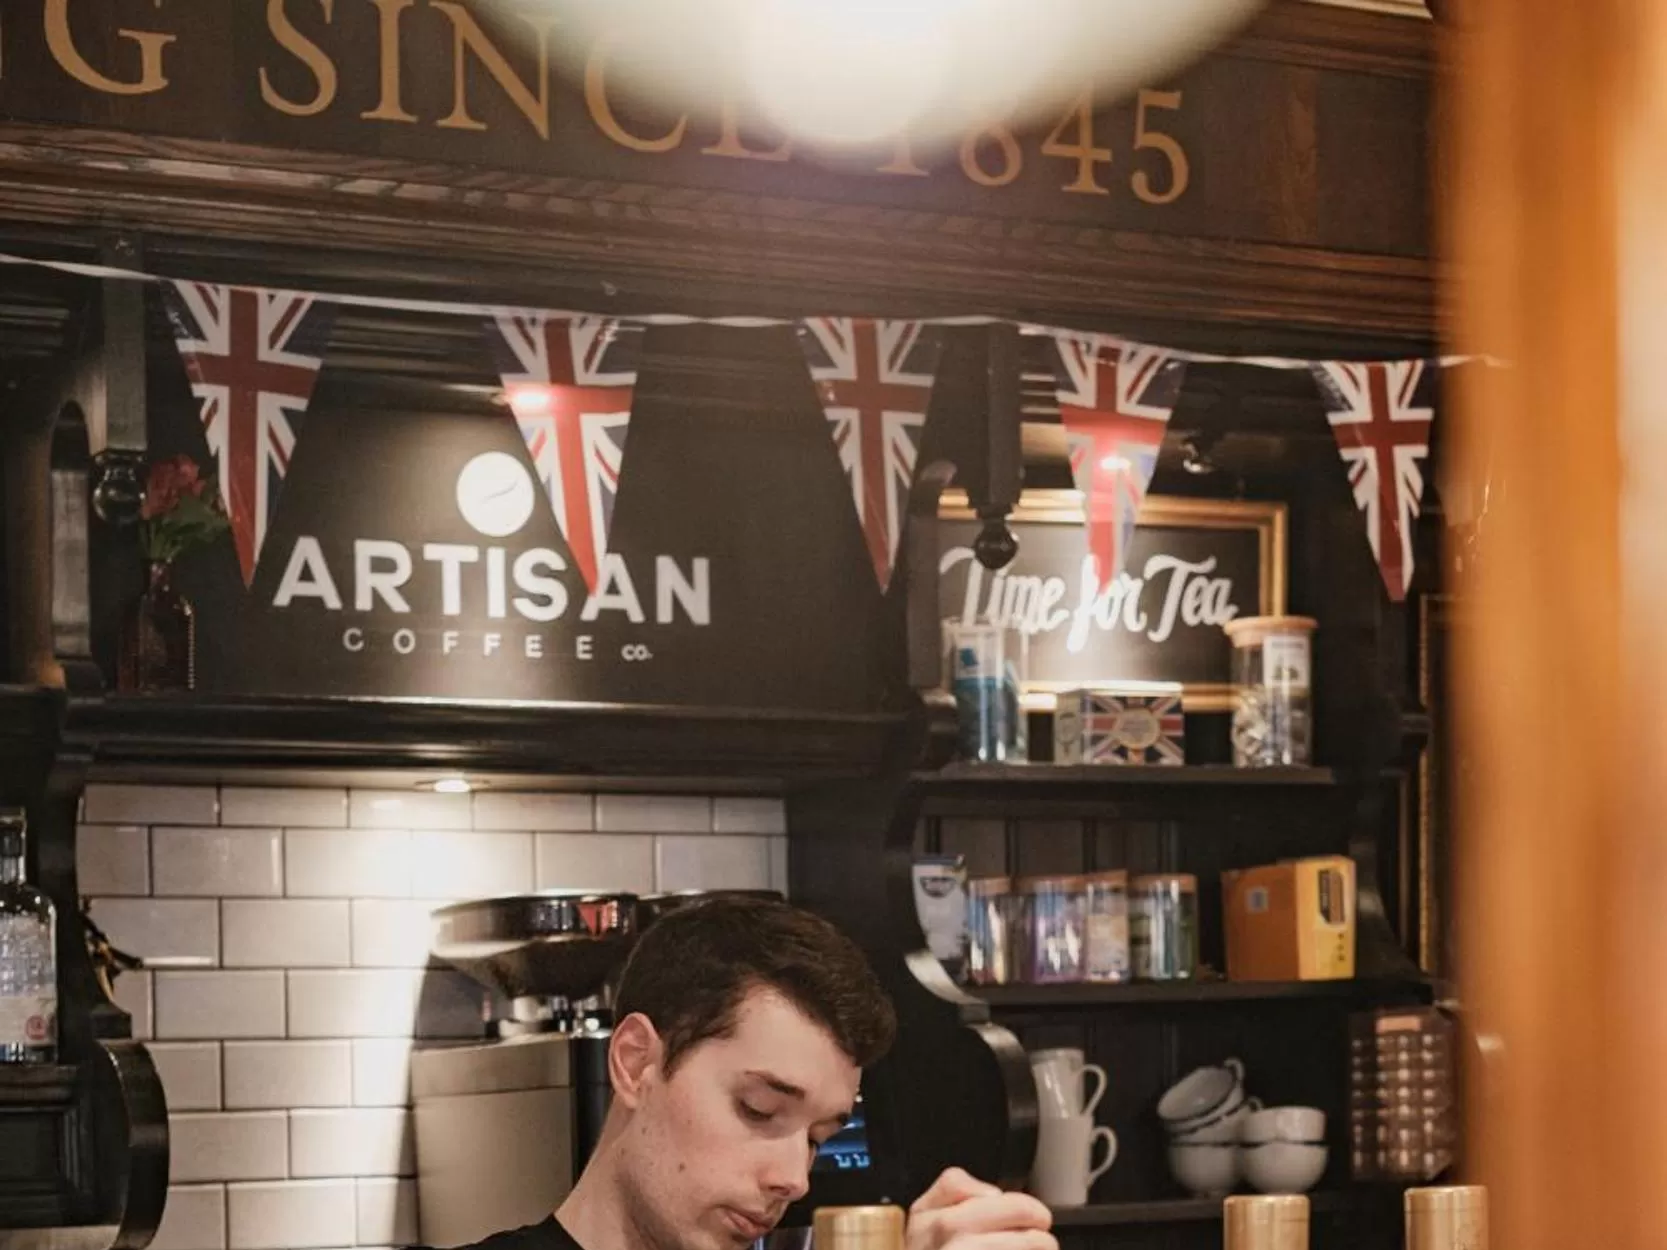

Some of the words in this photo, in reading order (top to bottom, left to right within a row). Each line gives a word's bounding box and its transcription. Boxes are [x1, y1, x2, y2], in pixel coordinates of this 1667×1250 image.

[273, 536, 710, 625] ARTISAN
[940, 547, 1073, 635] Time
[1066, 553, 1147, 654] for
[343, 627, 593, 660] COFFEE
